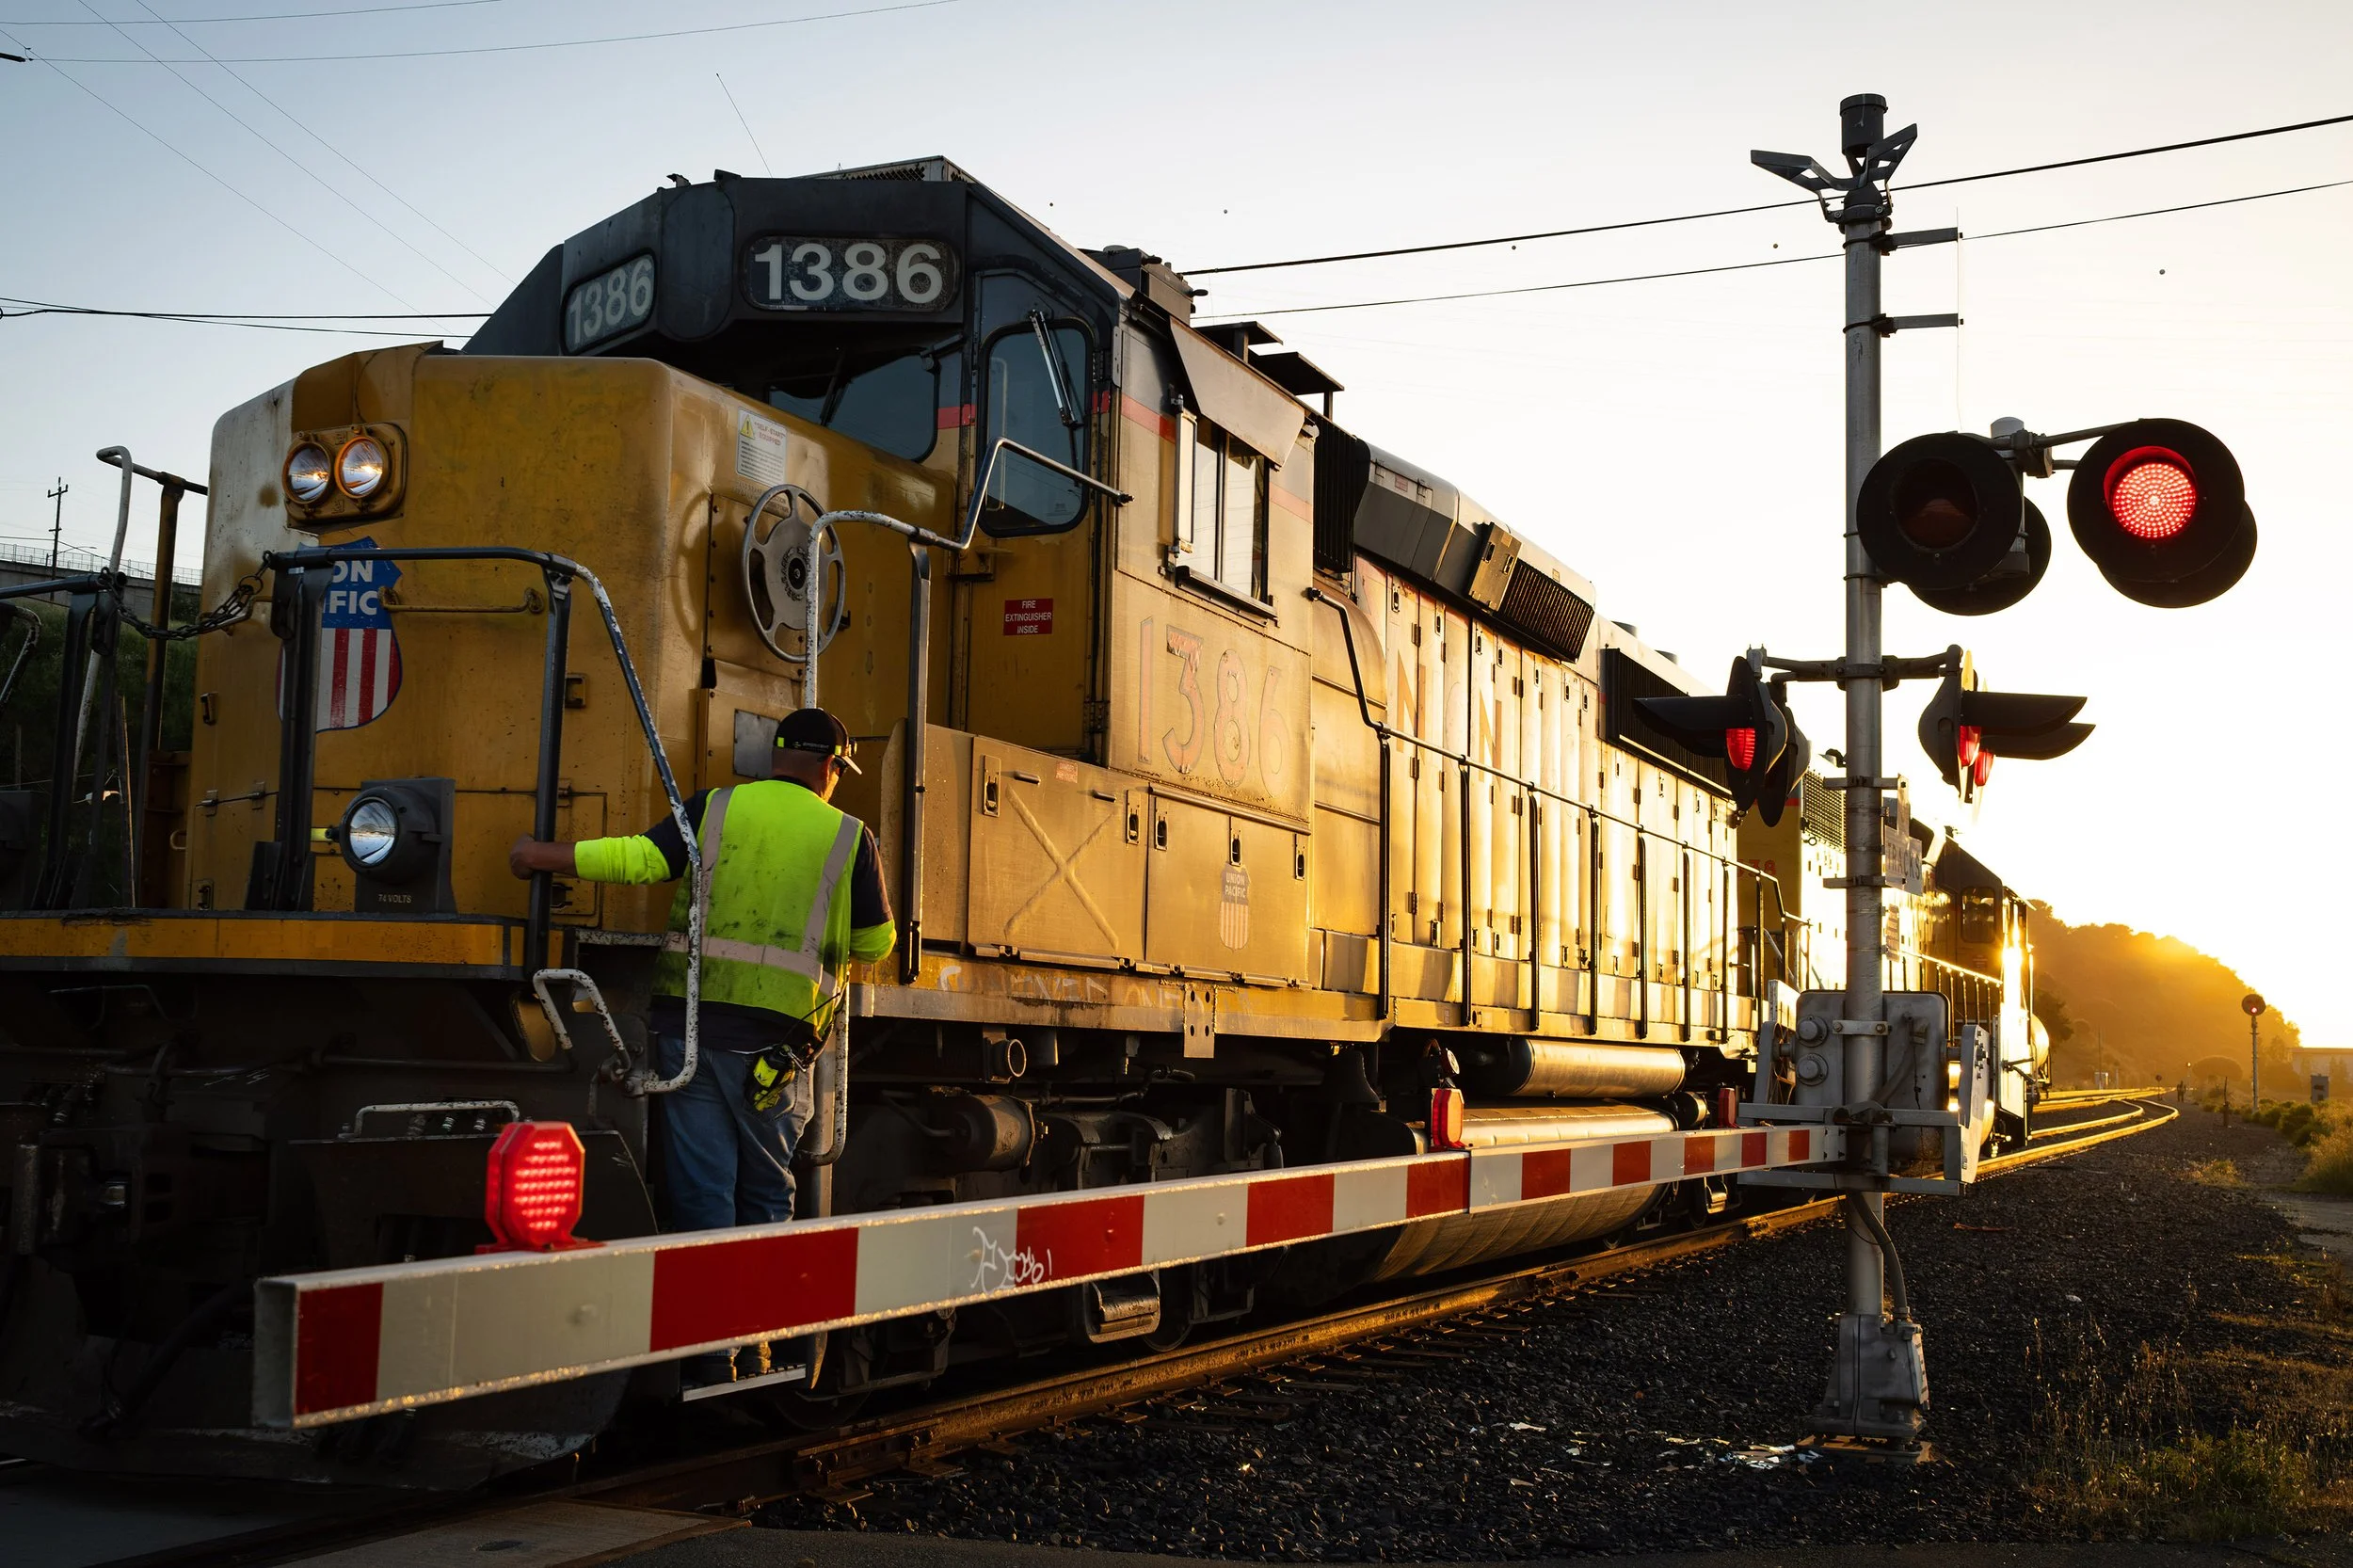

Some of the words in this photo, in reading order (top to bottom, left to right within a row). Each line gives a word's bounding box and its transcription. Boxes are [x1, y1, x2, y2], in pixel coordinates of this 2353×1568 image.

[754, 242, 943, 304] 1386
[568, 256, 654, 344] 1386
[1021, 600, 1036, 609] FIRE
[1004, 612, 1052, 622] EXTINGUISHER
[1016, 625, 1039, 634] INSIDE
[1137, 615, 1290, 799] 1386
[1886, 842, 1921, 880] TRACKS
[1225, 872, 1245, 886] UNION
[389, 894, 412, 904] VOLTS
[1225, 885, 1246, 899] PACIFIC
